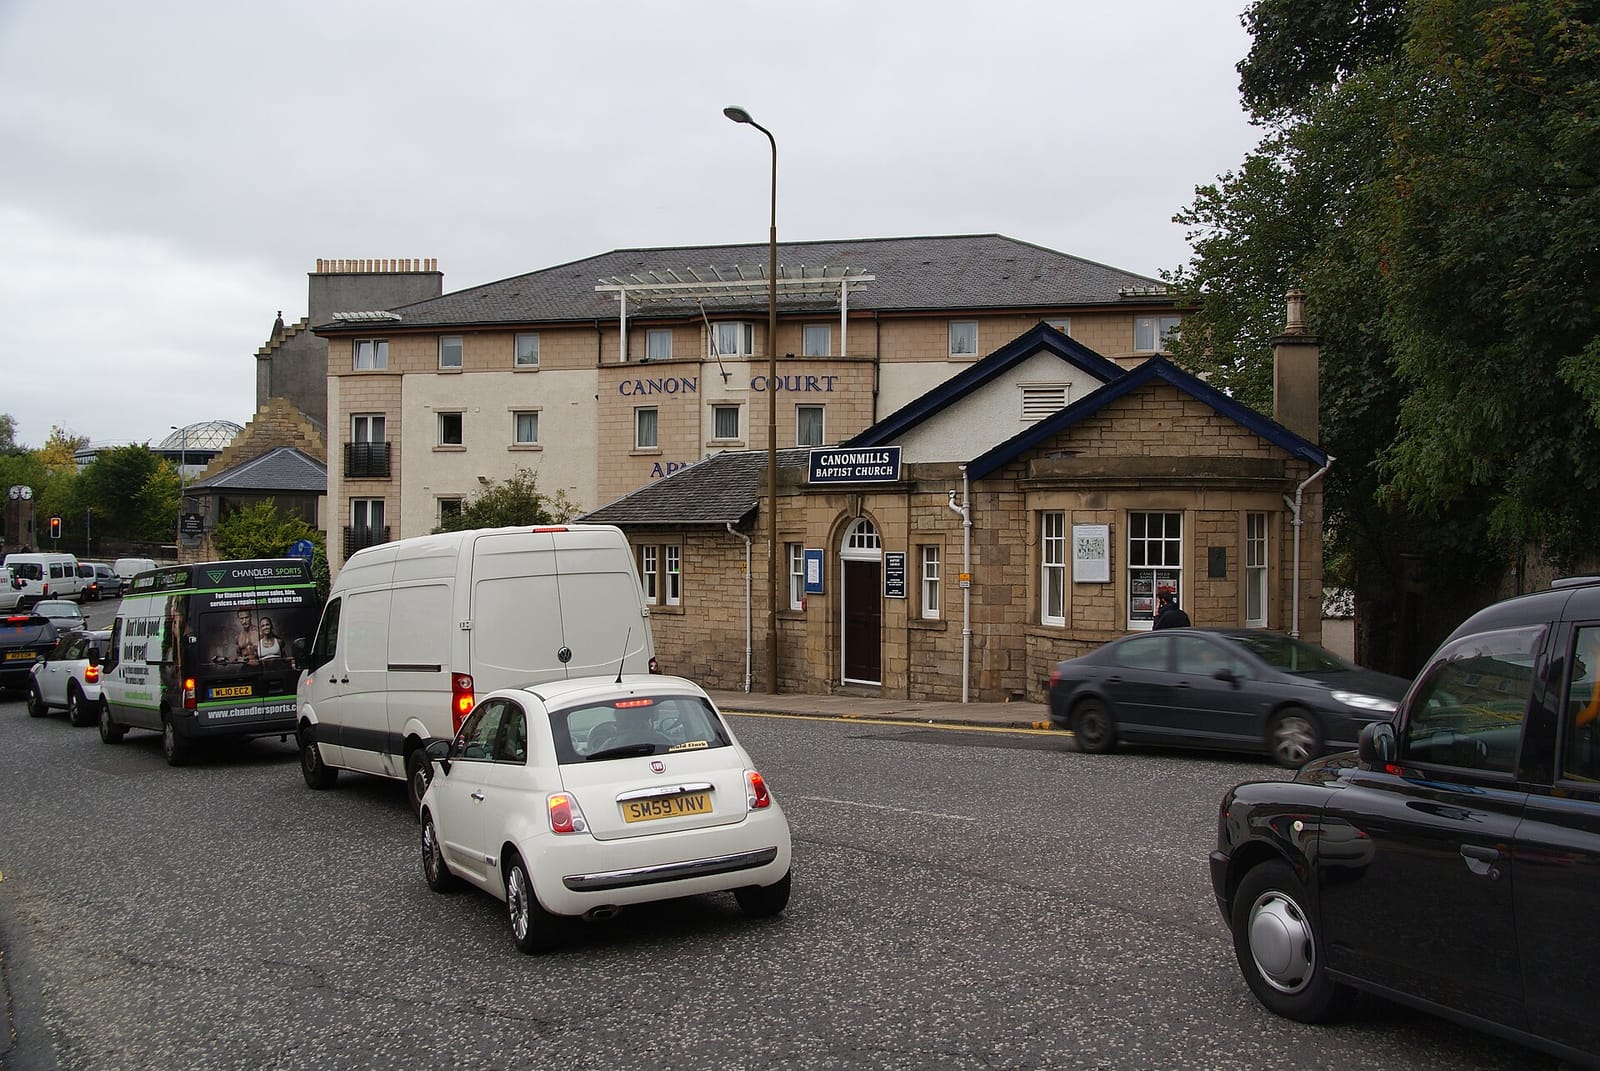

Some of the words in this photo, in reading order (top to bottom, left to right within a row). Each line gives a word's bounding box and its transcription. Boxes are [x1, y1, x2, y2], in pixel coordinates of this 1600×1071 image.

[619, 376, 698, 396] CANON
[751, 375, 838, 392] COURT
[820, 452, 890, 466] CANONMILLS
[816, 467, 853, 478] BAPTIST
[855, 466, 893, 476] CHURCH
[232, 567, 273, 578] CHANDLER
[275, 567, 302, 575] SPORTS
[215, 688, 233, 696] WL10
[234, 687, 249, 695] ECZ
[630, 799, 672, 818] SM59
[674, 796, 704, 812] VNV
